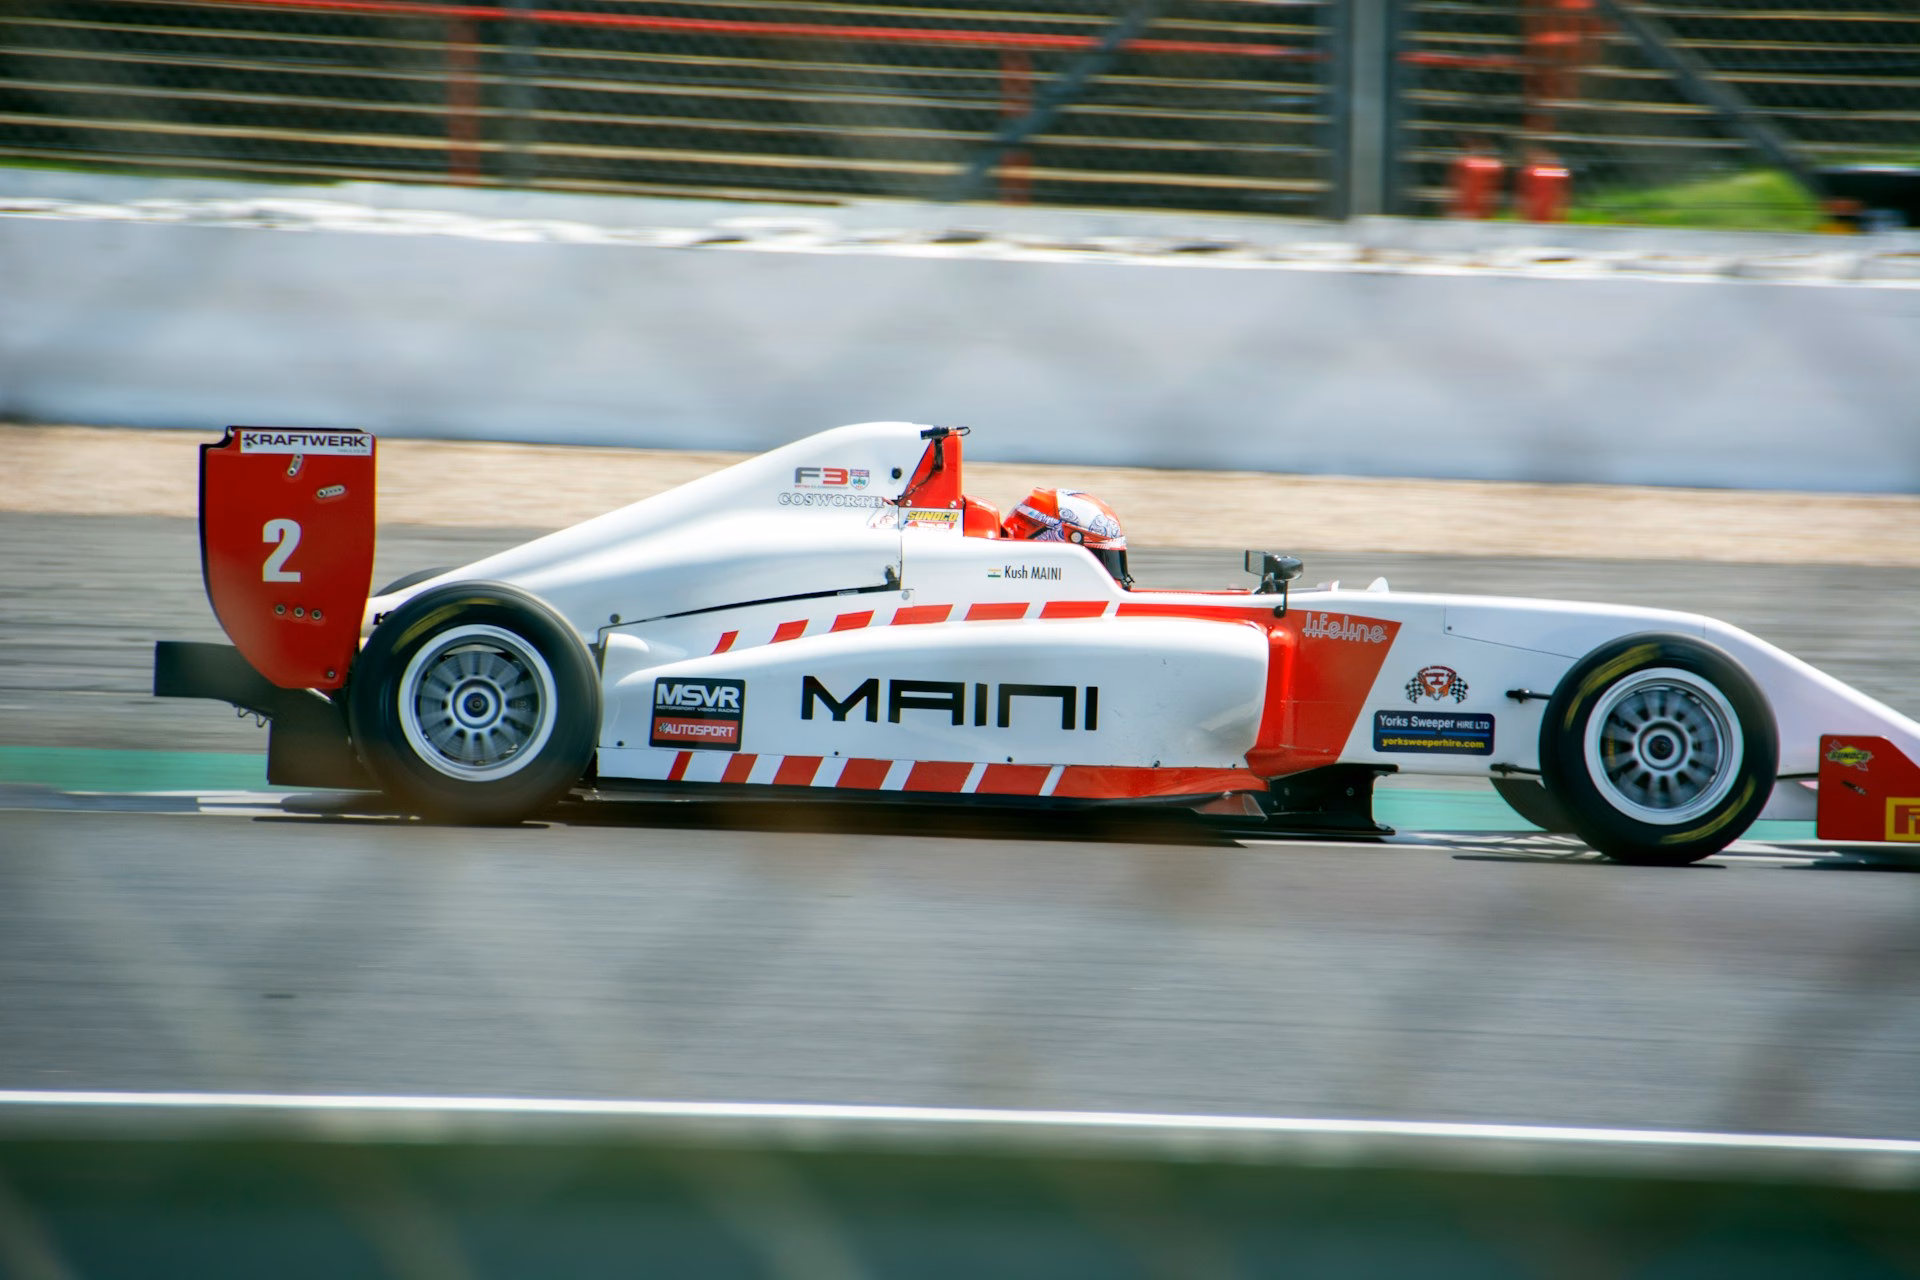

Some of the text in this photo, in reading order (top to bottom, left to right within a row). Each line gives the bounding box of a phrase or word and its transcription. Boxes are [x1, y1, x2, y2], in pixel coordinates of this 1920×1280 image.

[243, 433, 367, 447] KRAFTWERK
[795, 467, 848, 484] F3
[778, 492, 885, 509] COSWORTH
[907, 510, 959, 522] SUNOCO
[262, 518, 301, 582] 2
[1004, 566, 1062, 581] Kush MAINI
[1302, 612, 1387, 643] lifeline
[656, 683, 740, 709] MSVR
[801, 675, 1099, 731] MAINI
[663, 723, 735, 737] AUTOSPORT
[1379, 714, 1490, 730] Yorks Sweeper HIRE LTD
[1382, 737, 1485, 749] yorksweeperhire.com
